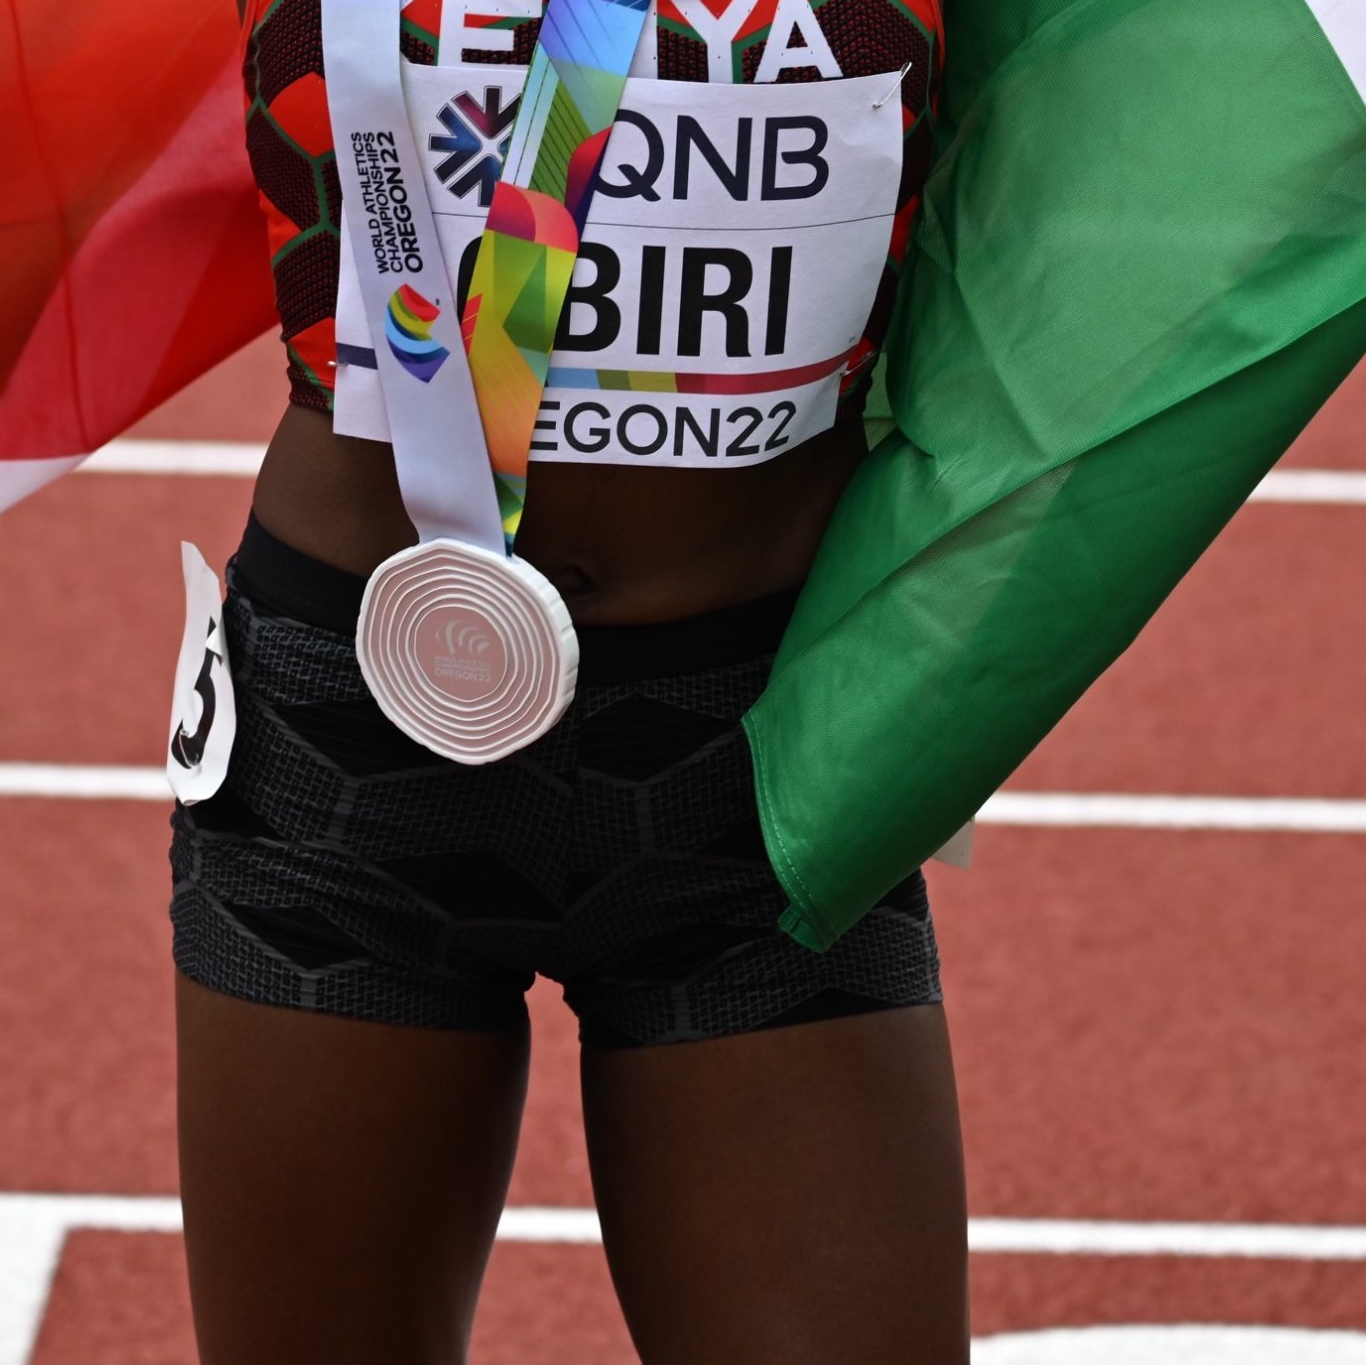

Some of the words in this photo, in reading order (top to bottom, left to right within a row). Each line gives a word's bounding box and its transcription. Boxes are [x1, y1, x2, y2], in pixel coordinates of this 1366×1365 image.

[351, 132, 378, 214] ATHLETICS
[593, 109, 829, 202] QNB
[363, 132, 403, 273] CHAMPIONSHIPS
[368, 219, 389, 274] WORLD
